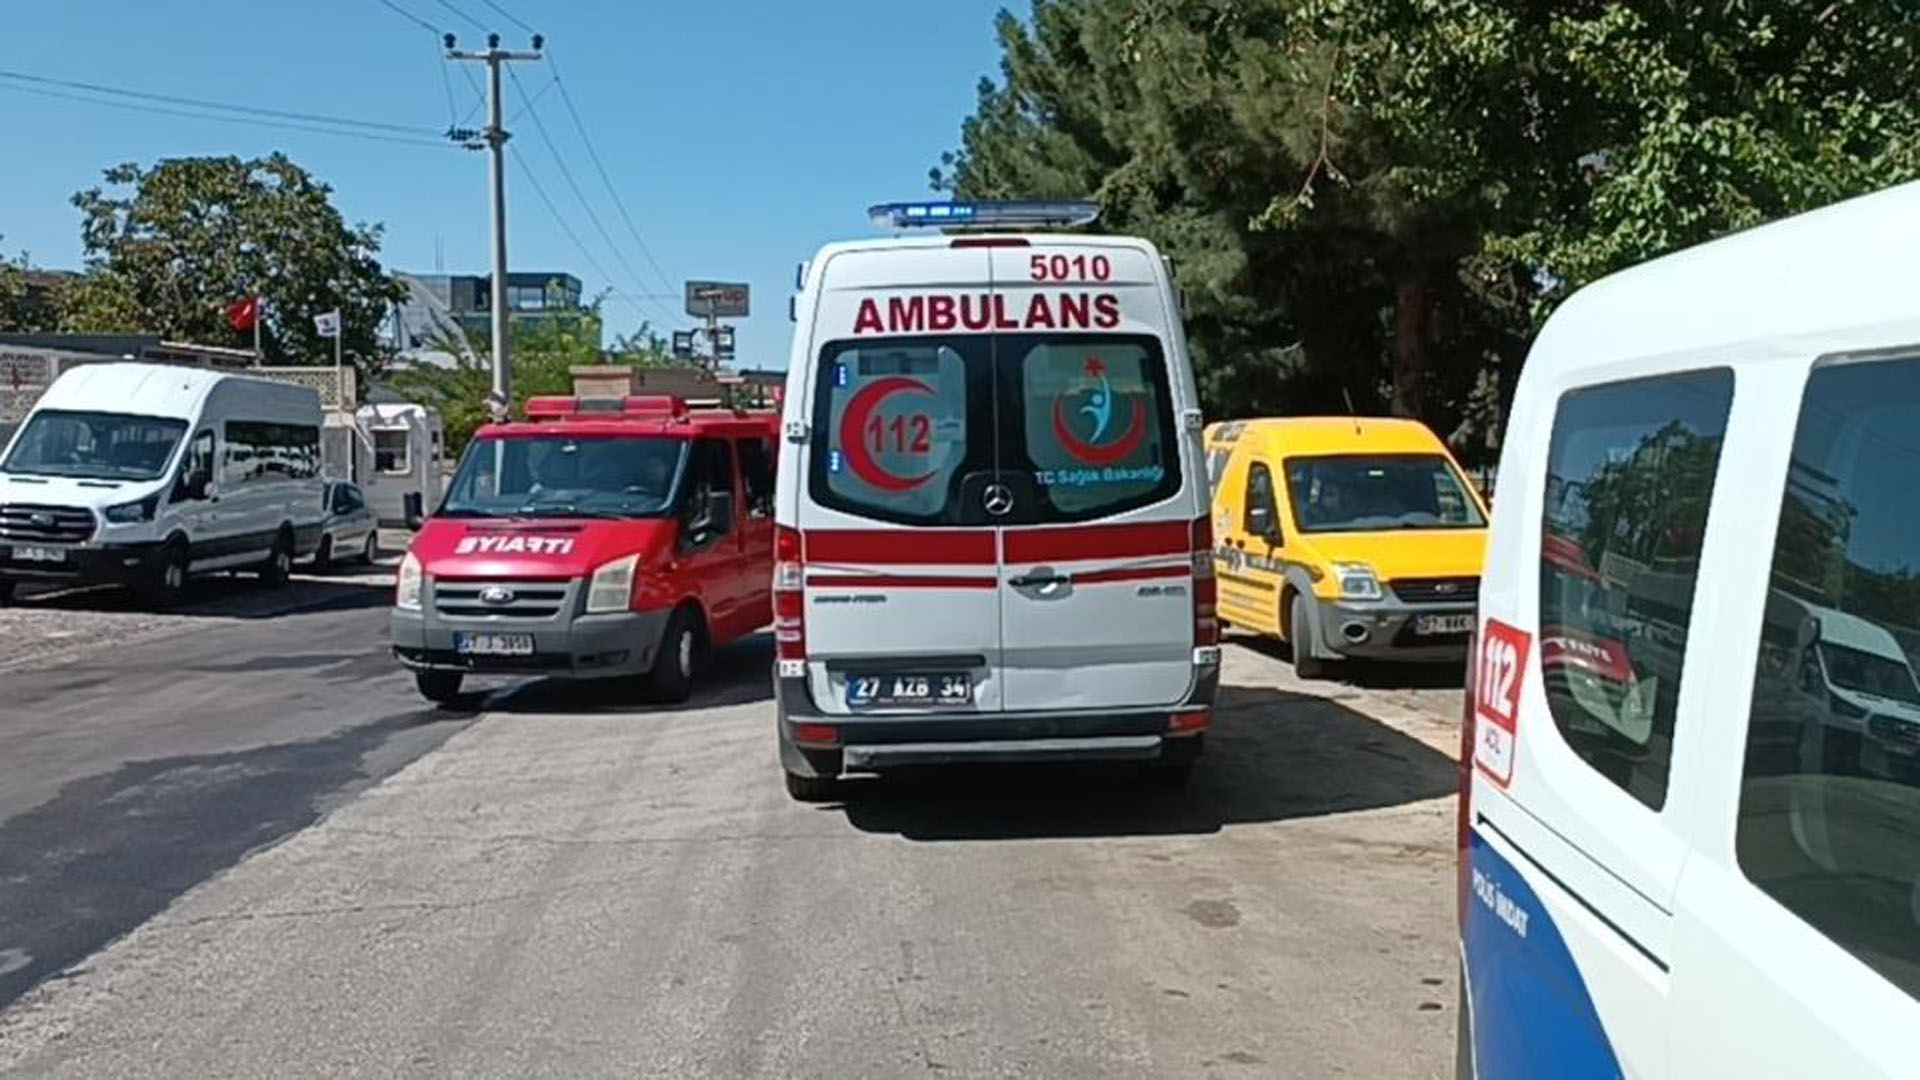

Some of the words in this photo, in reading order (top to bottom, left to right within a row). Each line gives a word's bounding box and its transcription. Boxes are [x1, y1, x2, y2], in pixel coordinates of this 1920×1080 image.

[1030, 254, 1110, 281] 5010
[853, 293, 1120, 334] AMBULANS
[868, 414, 931, 454] 112
[1034, 470, 1055, 485] TC
[856, 676, 880, 698] 27
[892, 676, 930, 698] AZB
[940, 674, 966, 698] 34
[1482, 636, 1517, 719] 112
